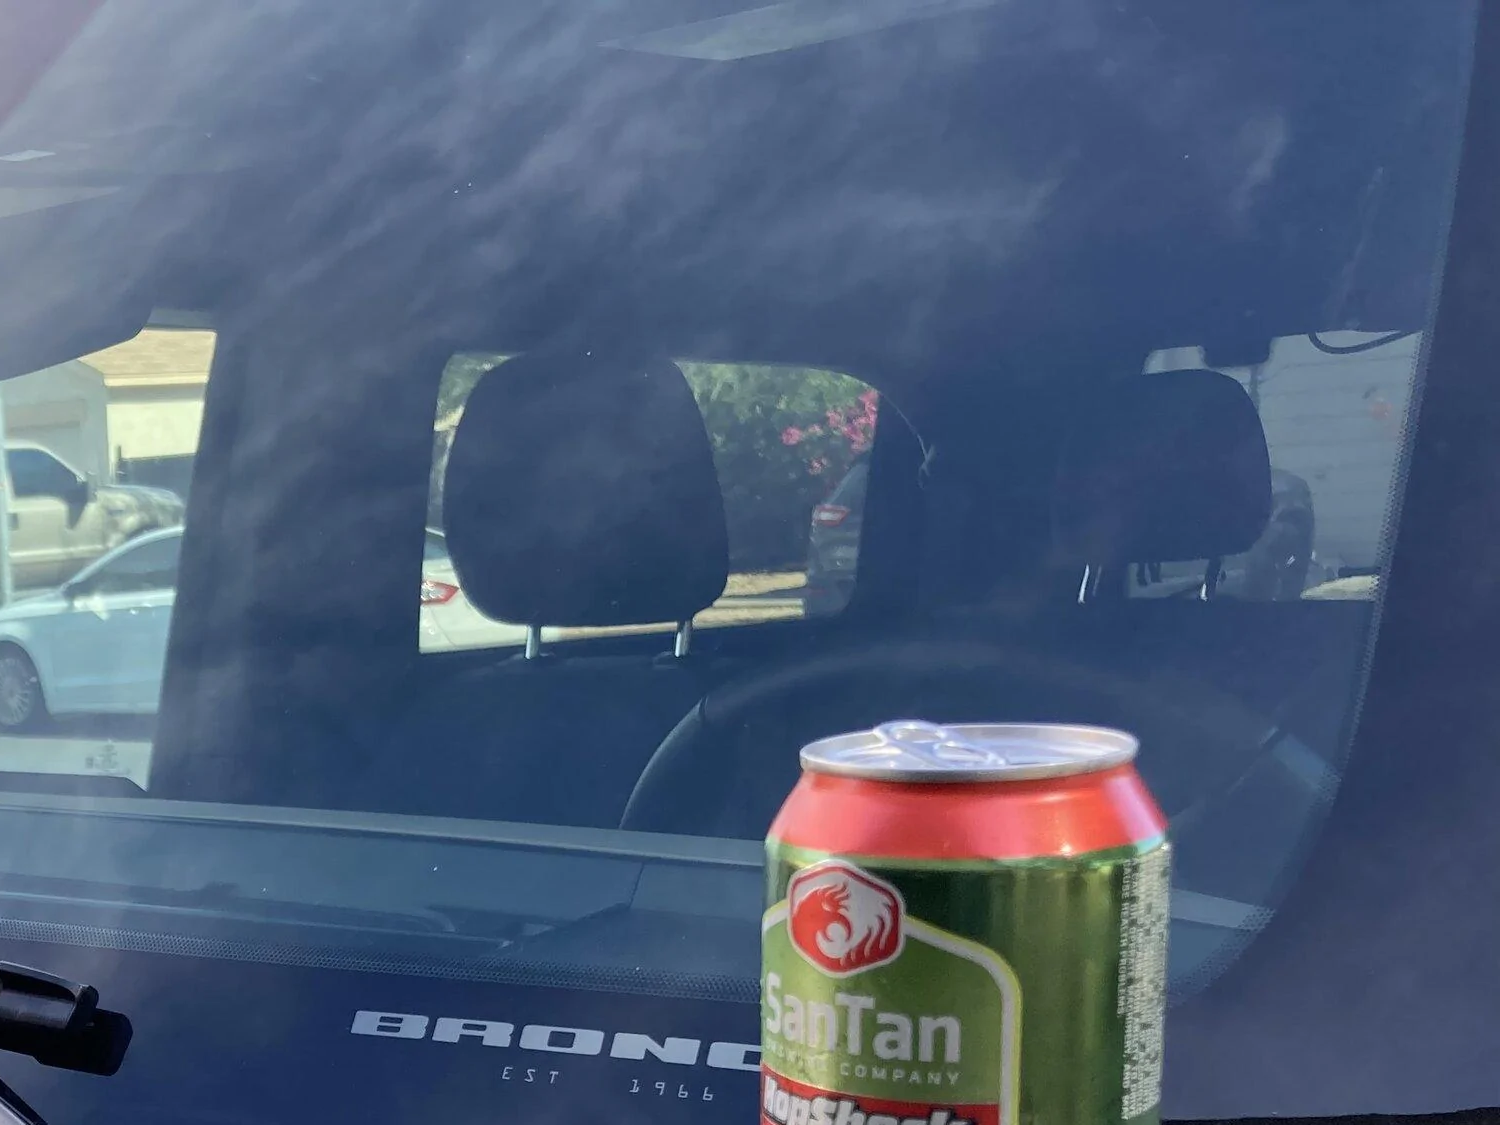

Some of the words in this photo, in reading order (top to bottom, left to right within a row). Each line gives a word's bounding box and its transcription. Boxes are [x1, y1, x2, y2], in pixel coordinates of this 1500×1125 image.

[766, 971, 961, 1063] SanTan
[501, 1065, 560, 1085] EST
[629, 1079, 715, 1101] 1966
[840, 1063, 961, 1085] COMPANY
